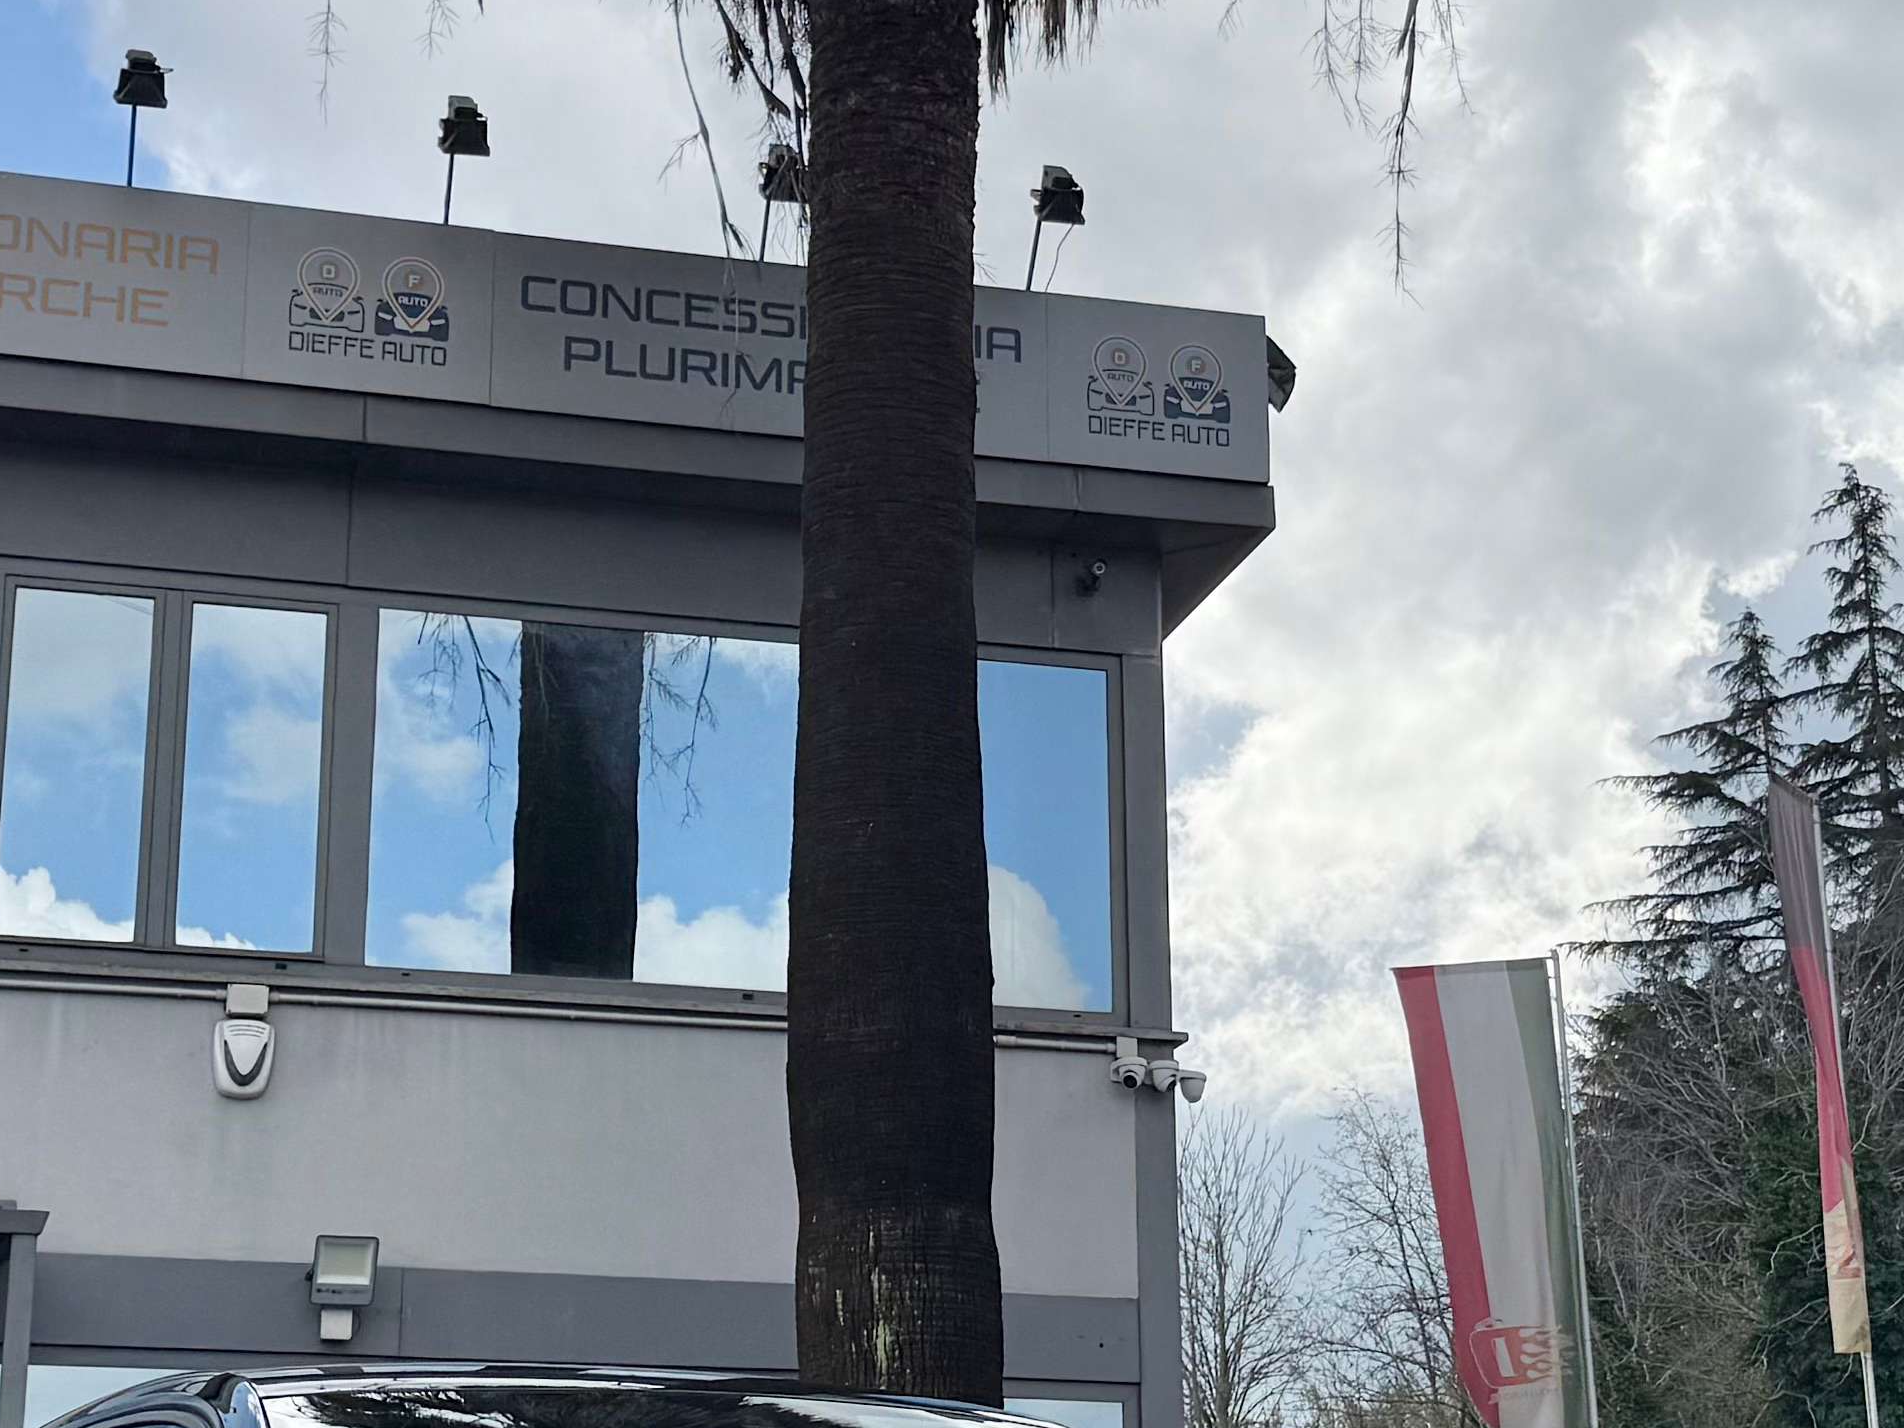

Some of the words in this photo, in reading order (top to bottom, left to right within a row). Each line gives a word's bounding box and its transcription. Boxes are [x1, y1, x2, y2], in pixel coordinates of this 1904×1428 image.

[398, 295, 429, 307] AUTO
[521, 275, 1022, 363] CONCESSIIA
[289, 331, 374, 359] DIEFFE
[382, 341, 447, 366] AUTO
[1107, 372, 1134, 383] AUTO
[1184, 380, 1210, 391] AUTO
[1088, 415, 1165, 441] DIEFFE
[1172, 424, 1230, 447] AUTO
